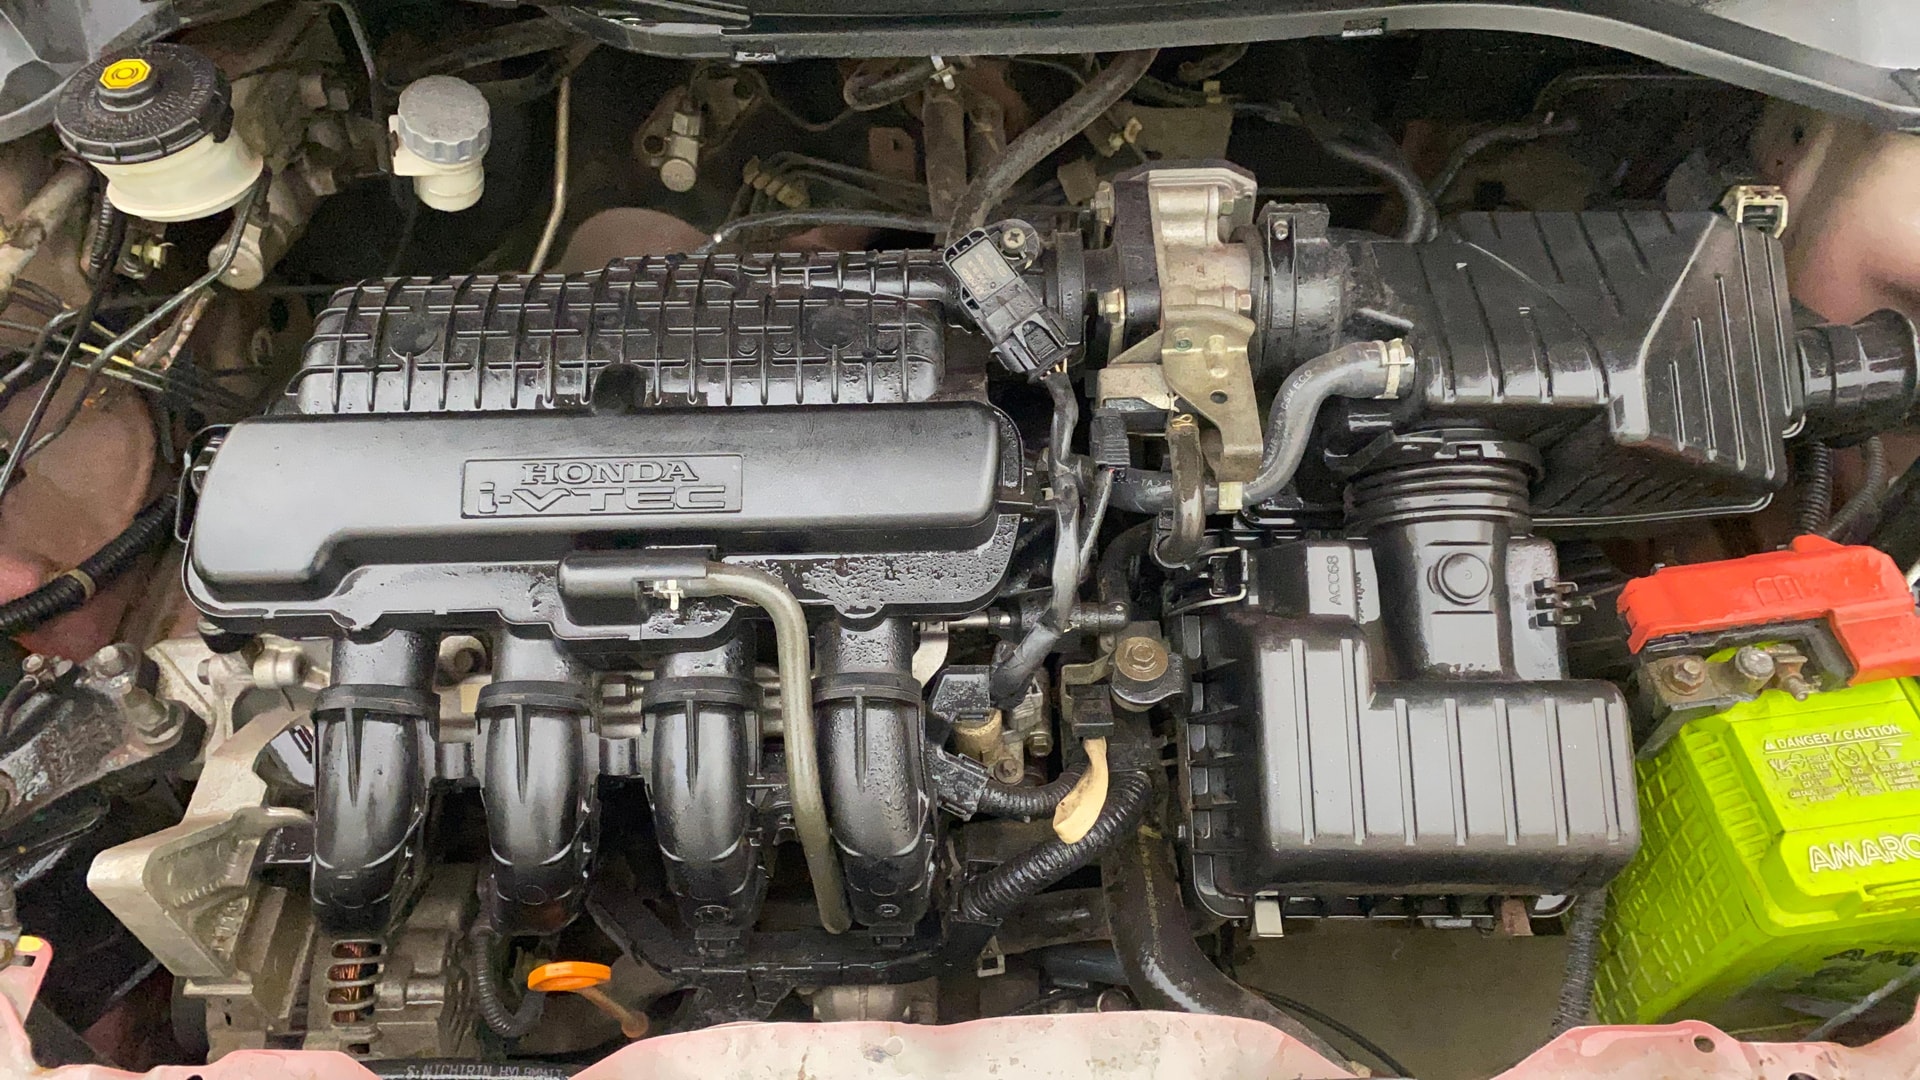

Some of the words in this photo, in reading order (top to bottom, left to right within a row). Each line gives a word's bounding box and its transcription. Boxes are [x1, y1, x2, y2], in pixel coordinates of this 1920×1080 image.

[520, 460, 699, 485] HONDA
[478, 482, 726, 514] i-VTEC
[1326, 555, 1342, 606] ACC68
[1775, 732, 1831, 750] DANGER
[1841, 724, 1903, 741] CAUTION
